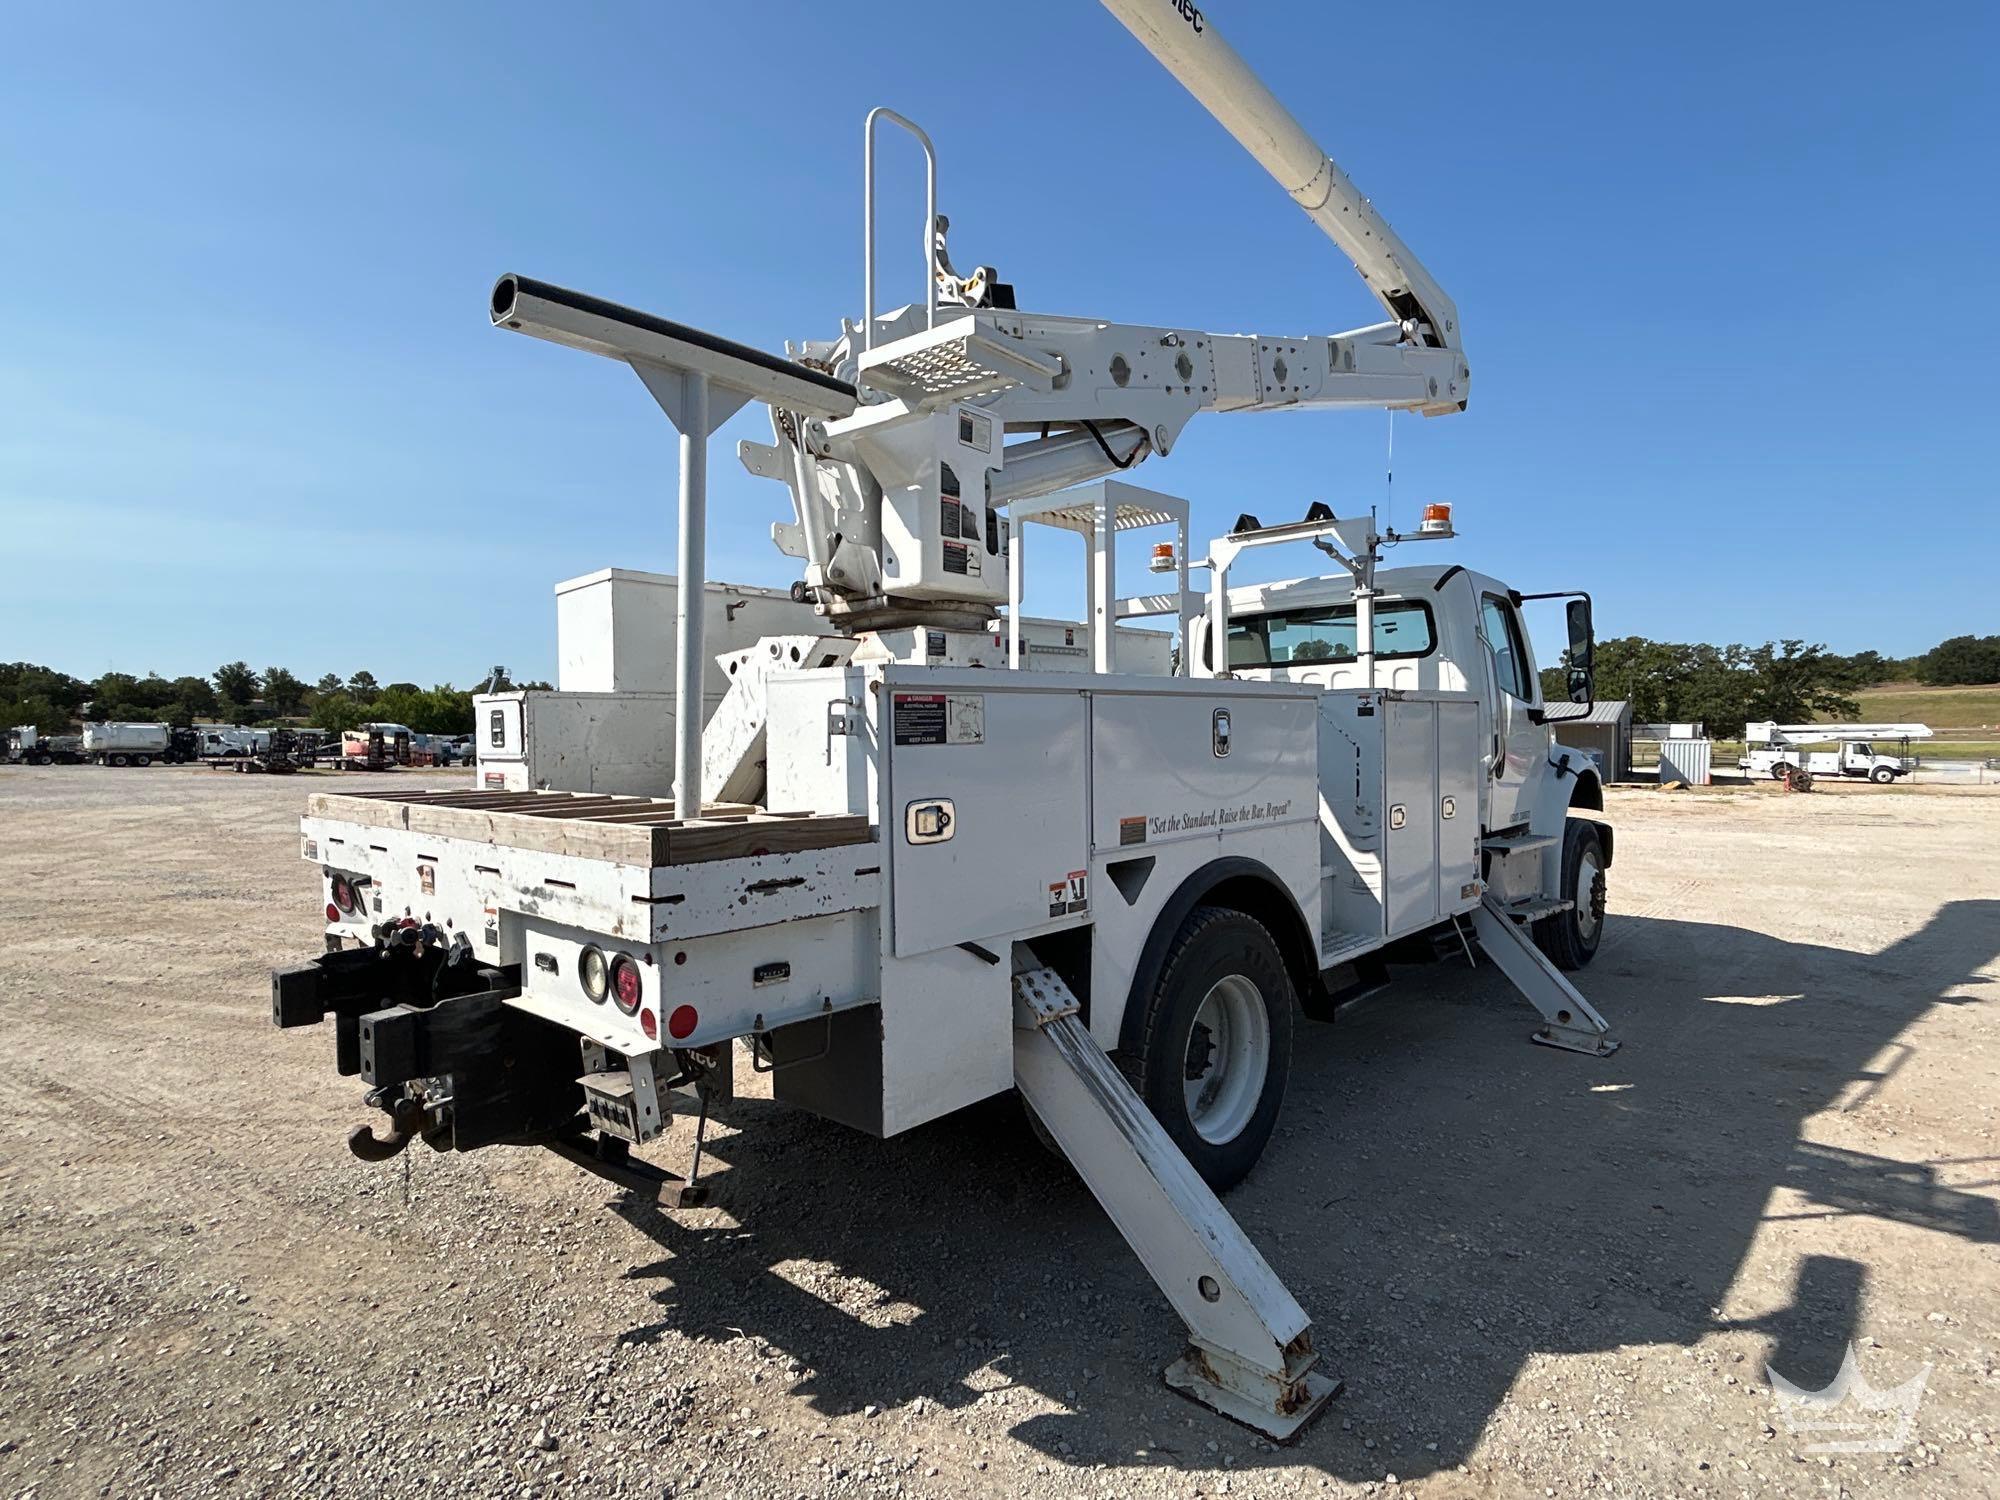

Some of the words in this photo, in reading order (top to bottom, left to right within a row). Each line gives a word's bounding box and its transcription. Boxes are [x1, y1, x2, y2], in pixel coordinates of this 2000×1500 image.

[1149, 816, 1166, 835] "Set
[1167, 815, 1181, 832] the
[1182, 810, 1217, 830] Standard,
[1219, 807, 1239, 825] Raise
[1240, 806, 1251, 821] the
